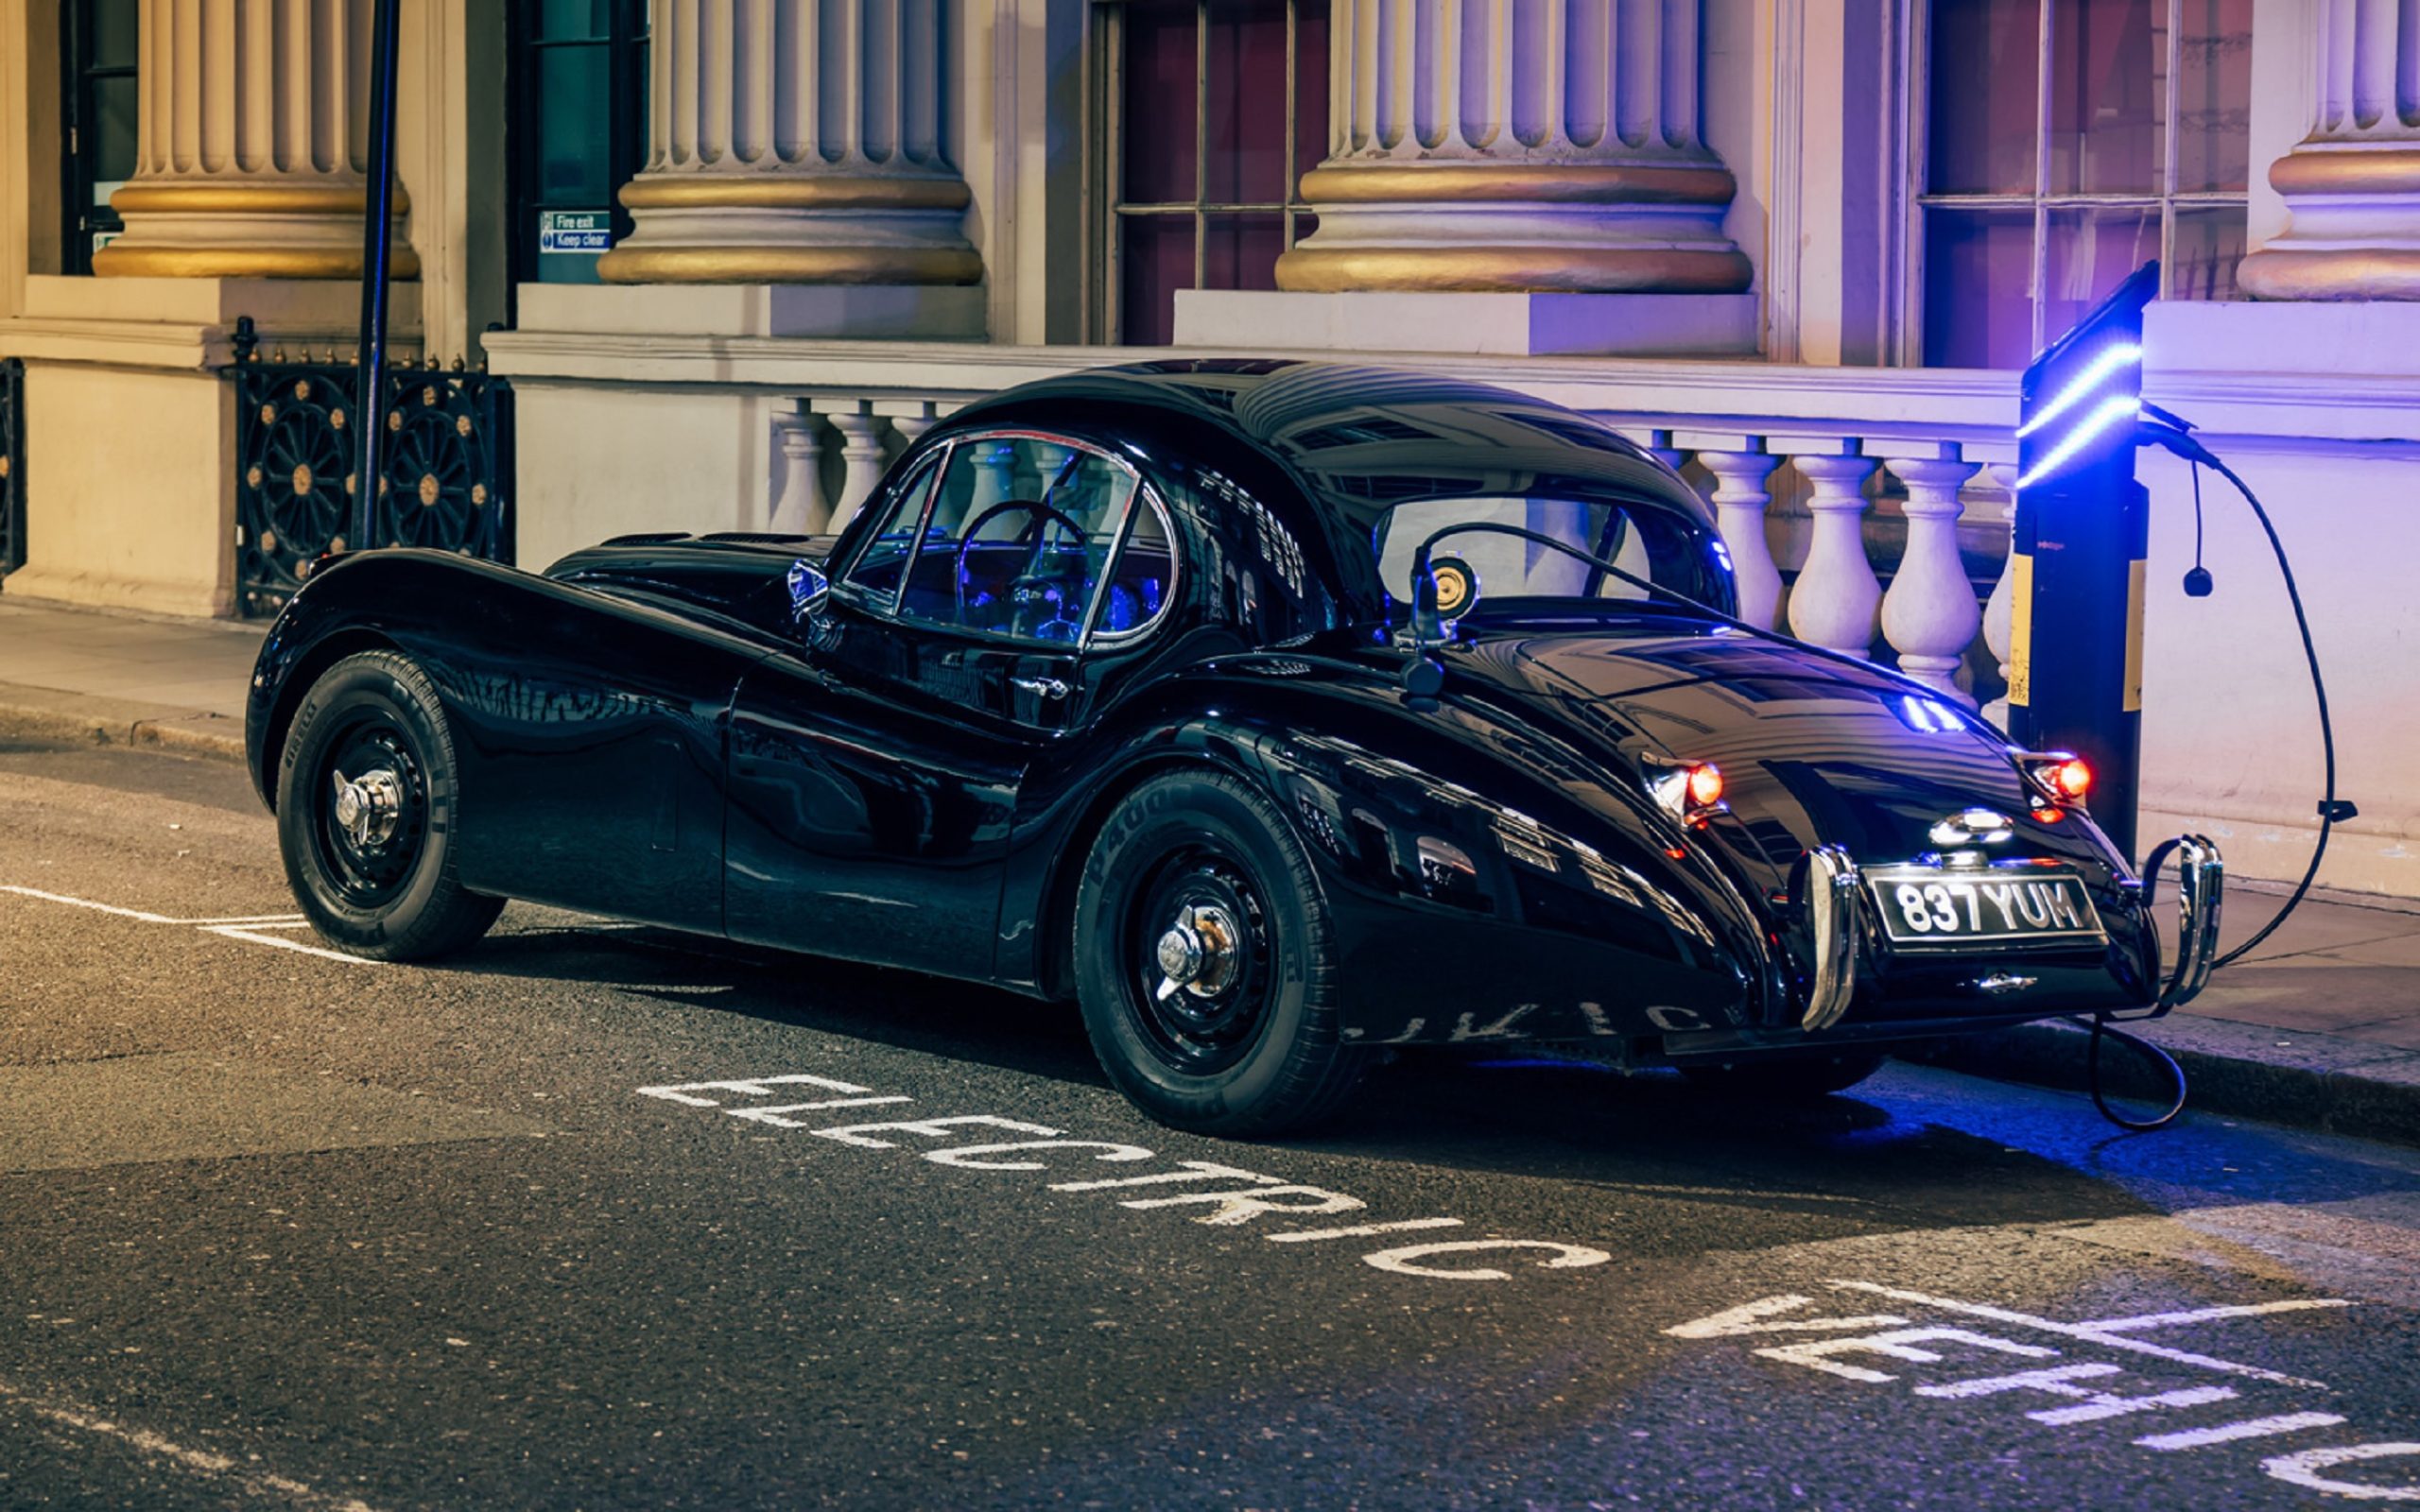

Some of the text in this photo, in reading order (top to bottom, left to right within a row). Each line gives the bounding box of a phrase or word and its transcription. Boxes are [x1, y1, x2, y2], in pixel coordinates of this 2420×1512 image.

[556, 215, 595, 229] Fire exit
[557, 233, 606, 249] Keep clear
[635, 1073, 1611, 1280] ELECTRIC
